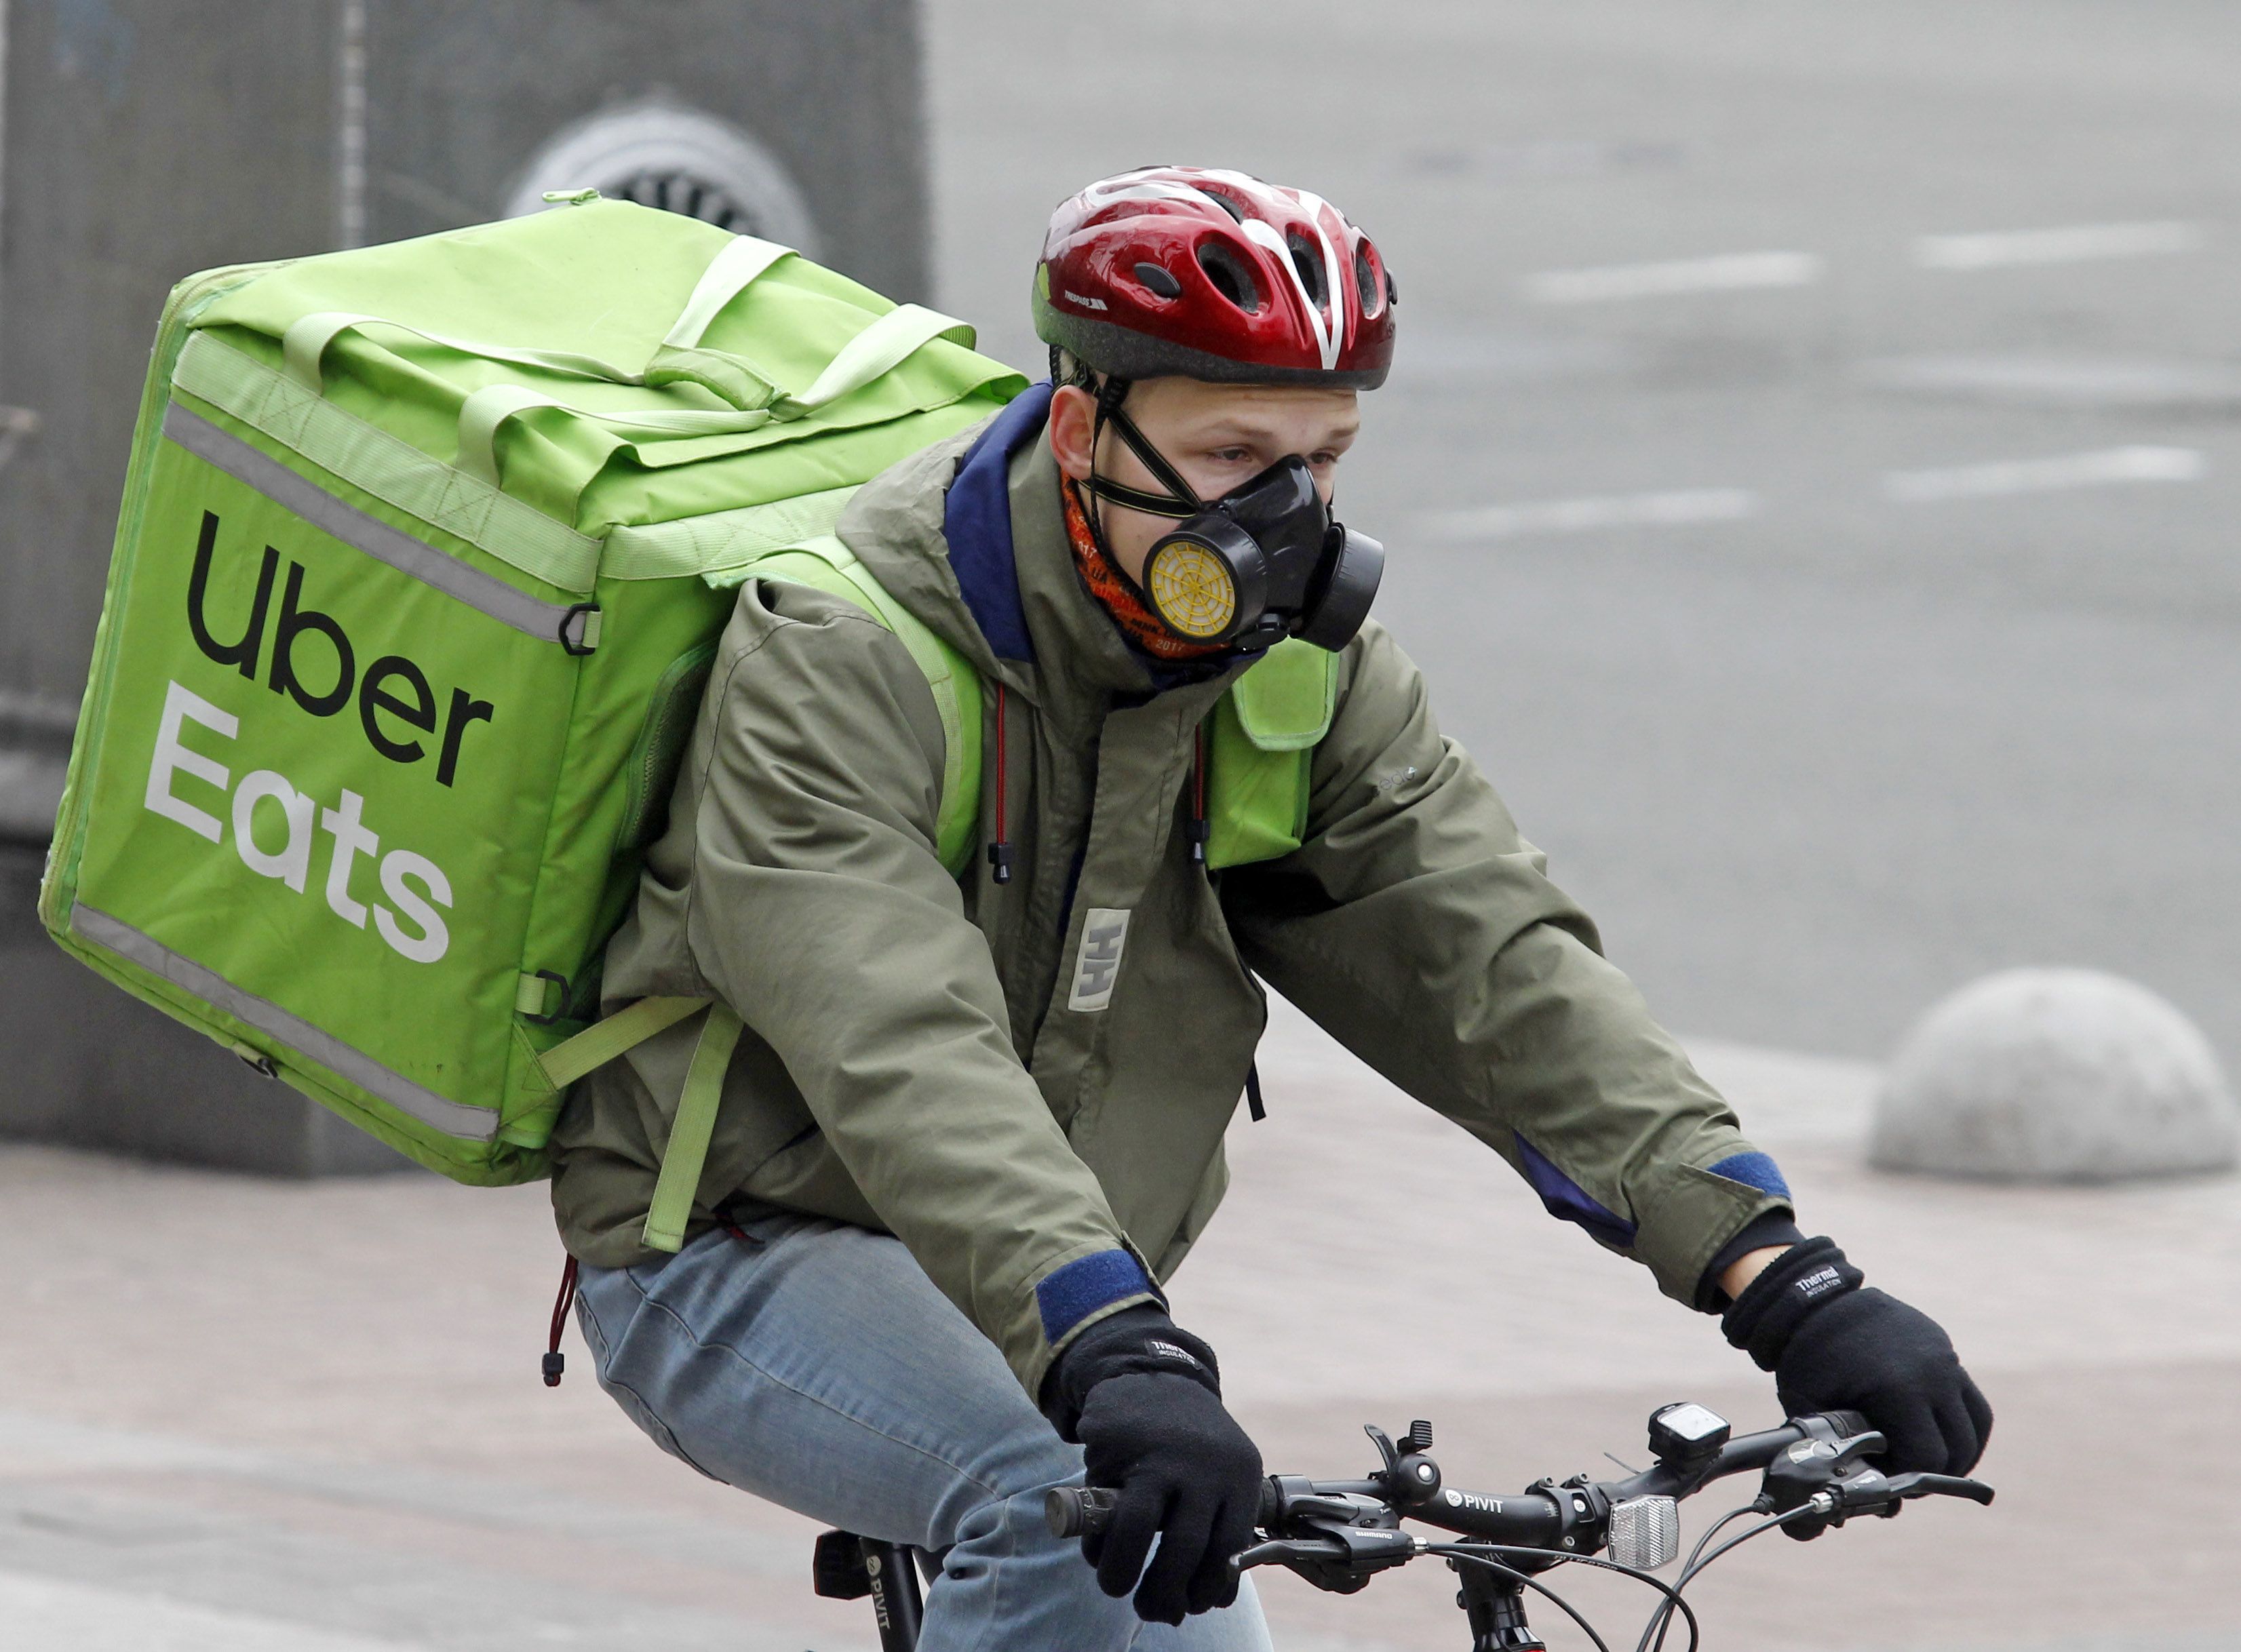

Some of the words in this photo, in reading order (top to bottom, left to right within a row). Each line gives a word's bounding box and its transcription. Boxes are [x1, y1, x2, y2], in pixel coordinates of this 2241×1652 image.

[186, 509, 494, 788] Uber
[143, 679, 454, 965] Eats
[1795, 1265, 1839, 1291] Thermal
[1463, 1494, 1504, 1514] PIVIT
[1355, 1531, 1393, 1539] SHIMANO
[871, 1577, 891, 1629] PIVIT
